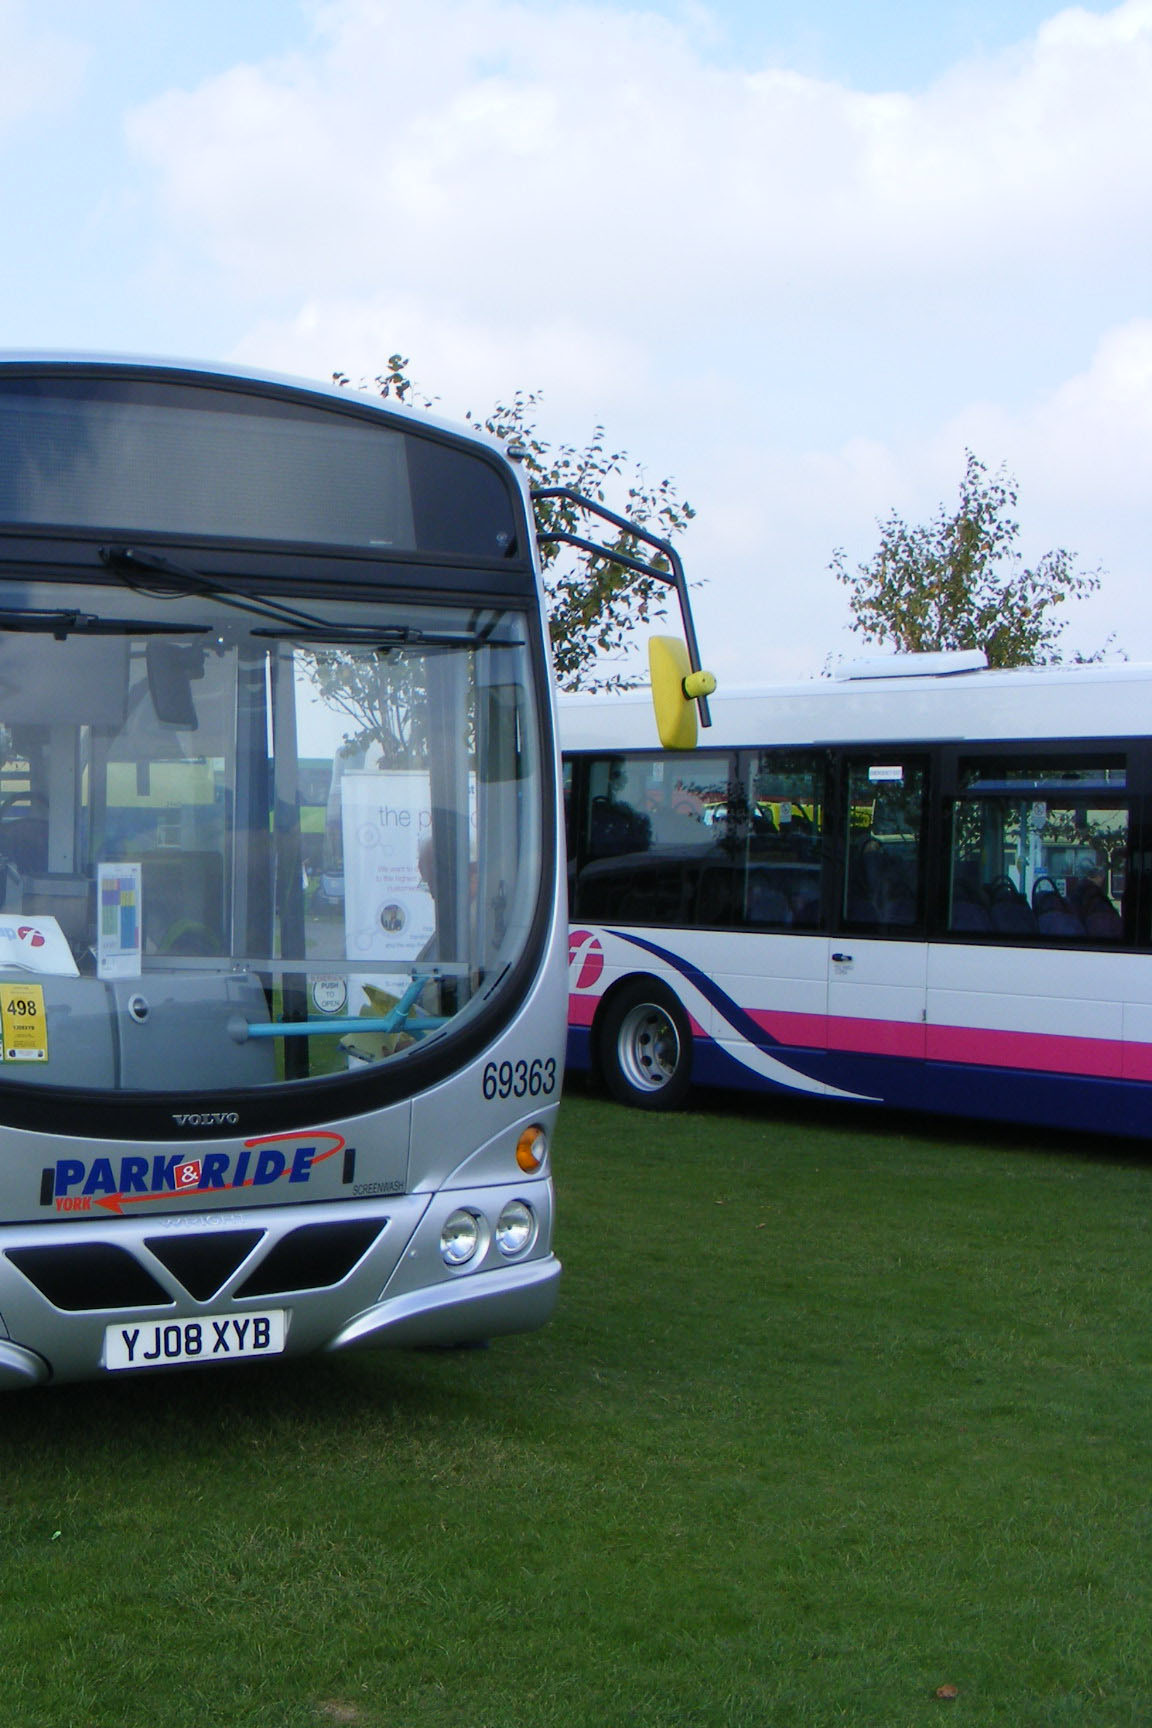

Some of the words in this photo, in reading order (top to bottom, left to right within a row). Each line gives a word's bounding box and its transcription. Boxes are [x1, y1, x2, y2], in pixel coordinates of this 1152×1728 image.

[379, 805, 411, 828] the
[7, 1000, 37, 1016] 498
[482, 1057, 557, 1100] 69363
[171, 1112, 240, 1126] VOLVO
[54, 1154, 186, 1197] PARK
[181, 1165, 199, 1183] &
[197, 1147, 317, 1191] RIDE
[55, 1196, 93, 1213] YORK
[121, 1324, 203, 1362] YJ08
[212, 1317, 271, 1353] XYB
